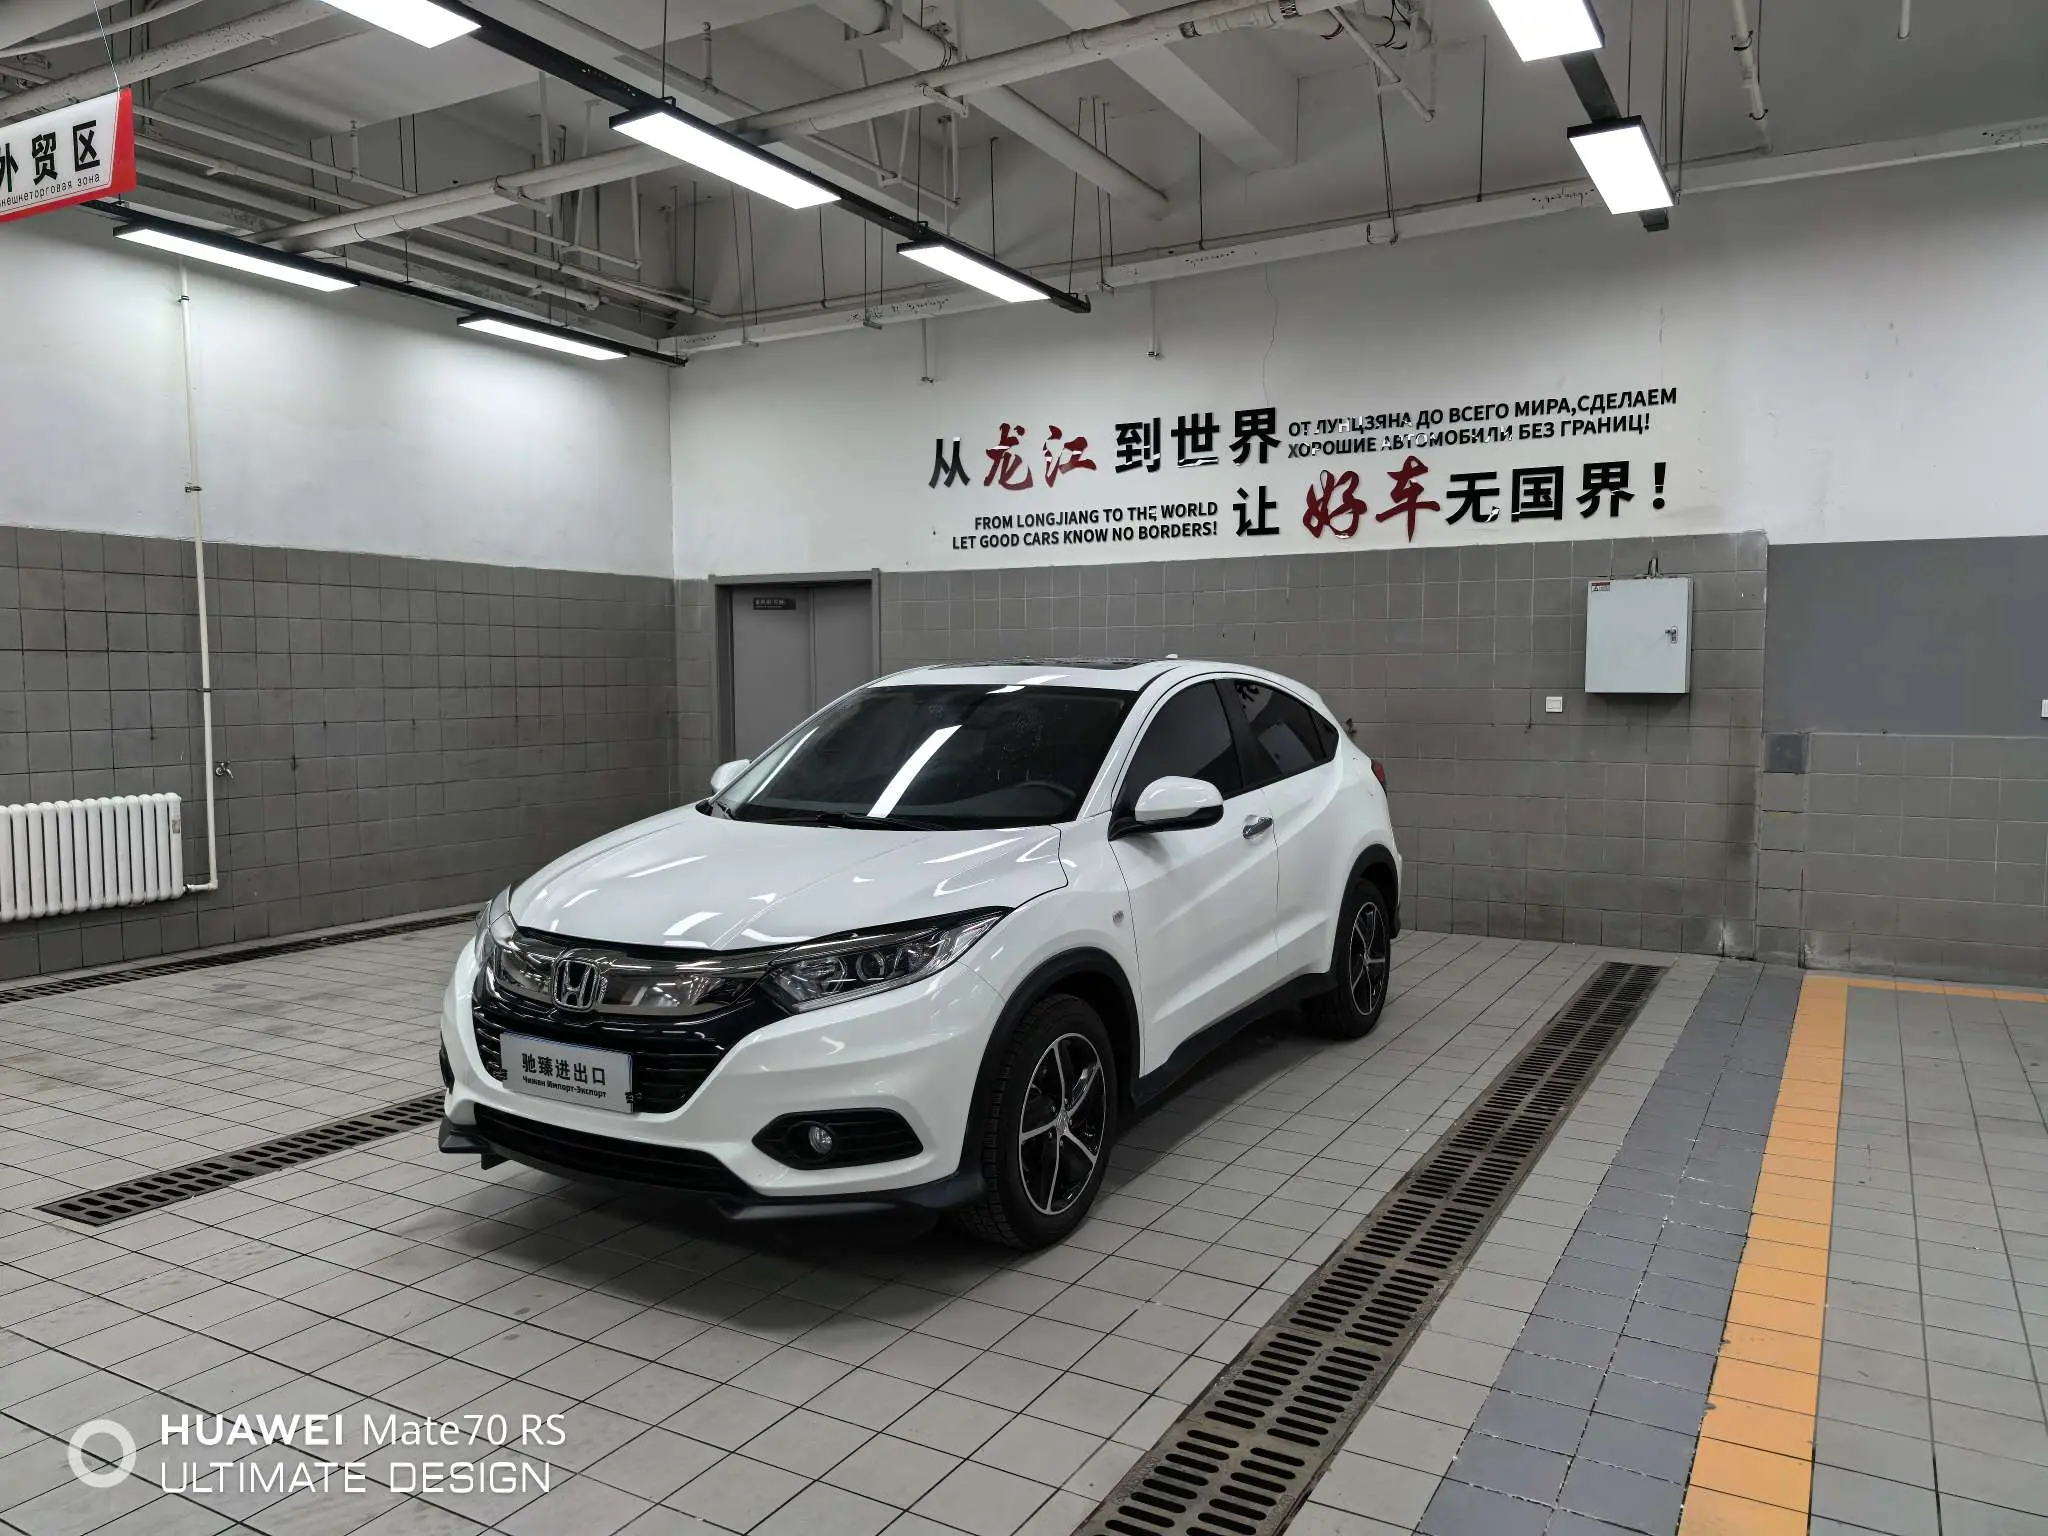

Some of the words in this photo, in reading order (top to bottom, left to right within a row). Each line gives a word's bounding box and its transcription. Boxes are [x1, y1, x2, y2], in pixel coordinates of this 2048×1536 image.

[0, 119, 101, 193] 外贸区
[0, 181, 73, 208] нешнеторговая
[77, 173, 100, 187] зона
[1287, 437, 1377, 459] ХОРОШИЕ
[1381, 424, 1513, 452] АВТОМОБИЛИ
[1519, 421, 1555, 440] БЕЗ
[1560, 413, 1650, 437] ГРАНИЦ!
[1288, 421, 1311, 437] ОТ
[1314, 412, 1412, 435] ЛУНЦЗЯНА
[1416, 409, 1444, 430] ДО
[1449, 403, 1510, 424] ВСЕГО
[975, 515, 1014, 531] FROM
[1017, 509, 1100, 528] LONGJIANG
[1103, 508, 1123, 522] TO
[1127, 505, 1158, 521] THE
[1161, 501, 1218, 519] WORLD
[952, 535, 976, 550] LET
[980, 533, 1020, 548] GOOD
[1023, 531, 1060, 546] CARS
[1063, 528, 1108, 544] KNOW
[1112, 526, 1134, 541] NO
[1138, 521, 1218, 540] BORDERS!
